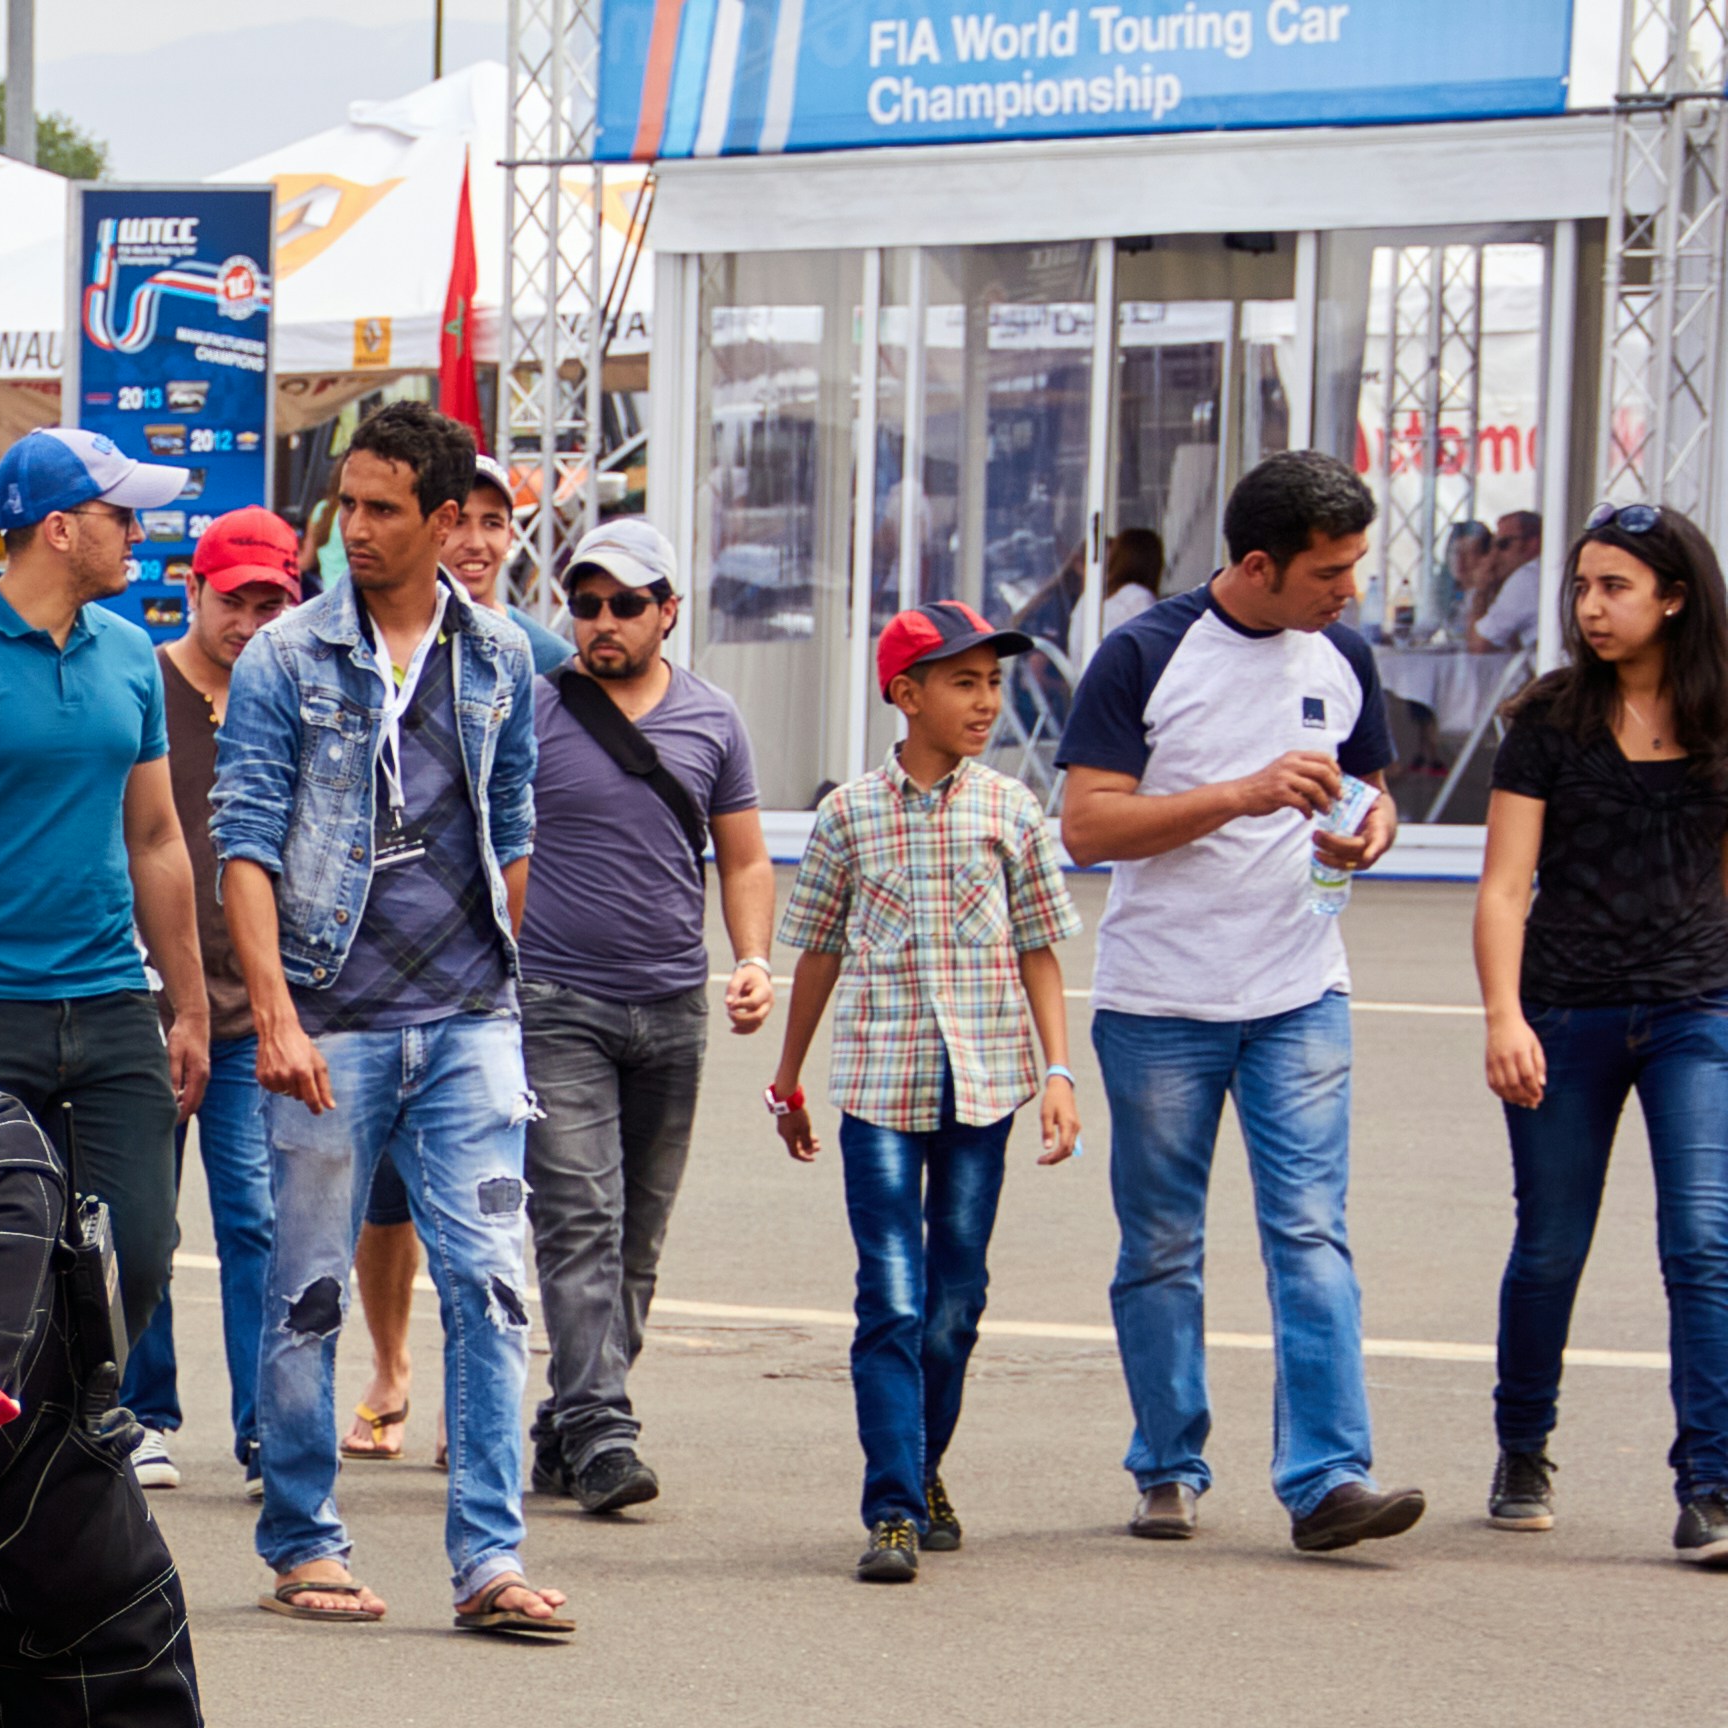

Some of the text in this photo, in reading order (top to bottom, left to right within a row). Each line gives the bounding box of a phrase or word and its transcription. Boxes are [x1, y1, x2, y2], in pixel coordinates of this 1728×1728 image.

[869, 0, 1347, 67] FIA World Touring Car
[867, 64, 1184, 128] Championship
[117, 217, 200, 244] WTCC
[118, 386, 163, 410] 2013
[190, 429, 233, 452] 2012
